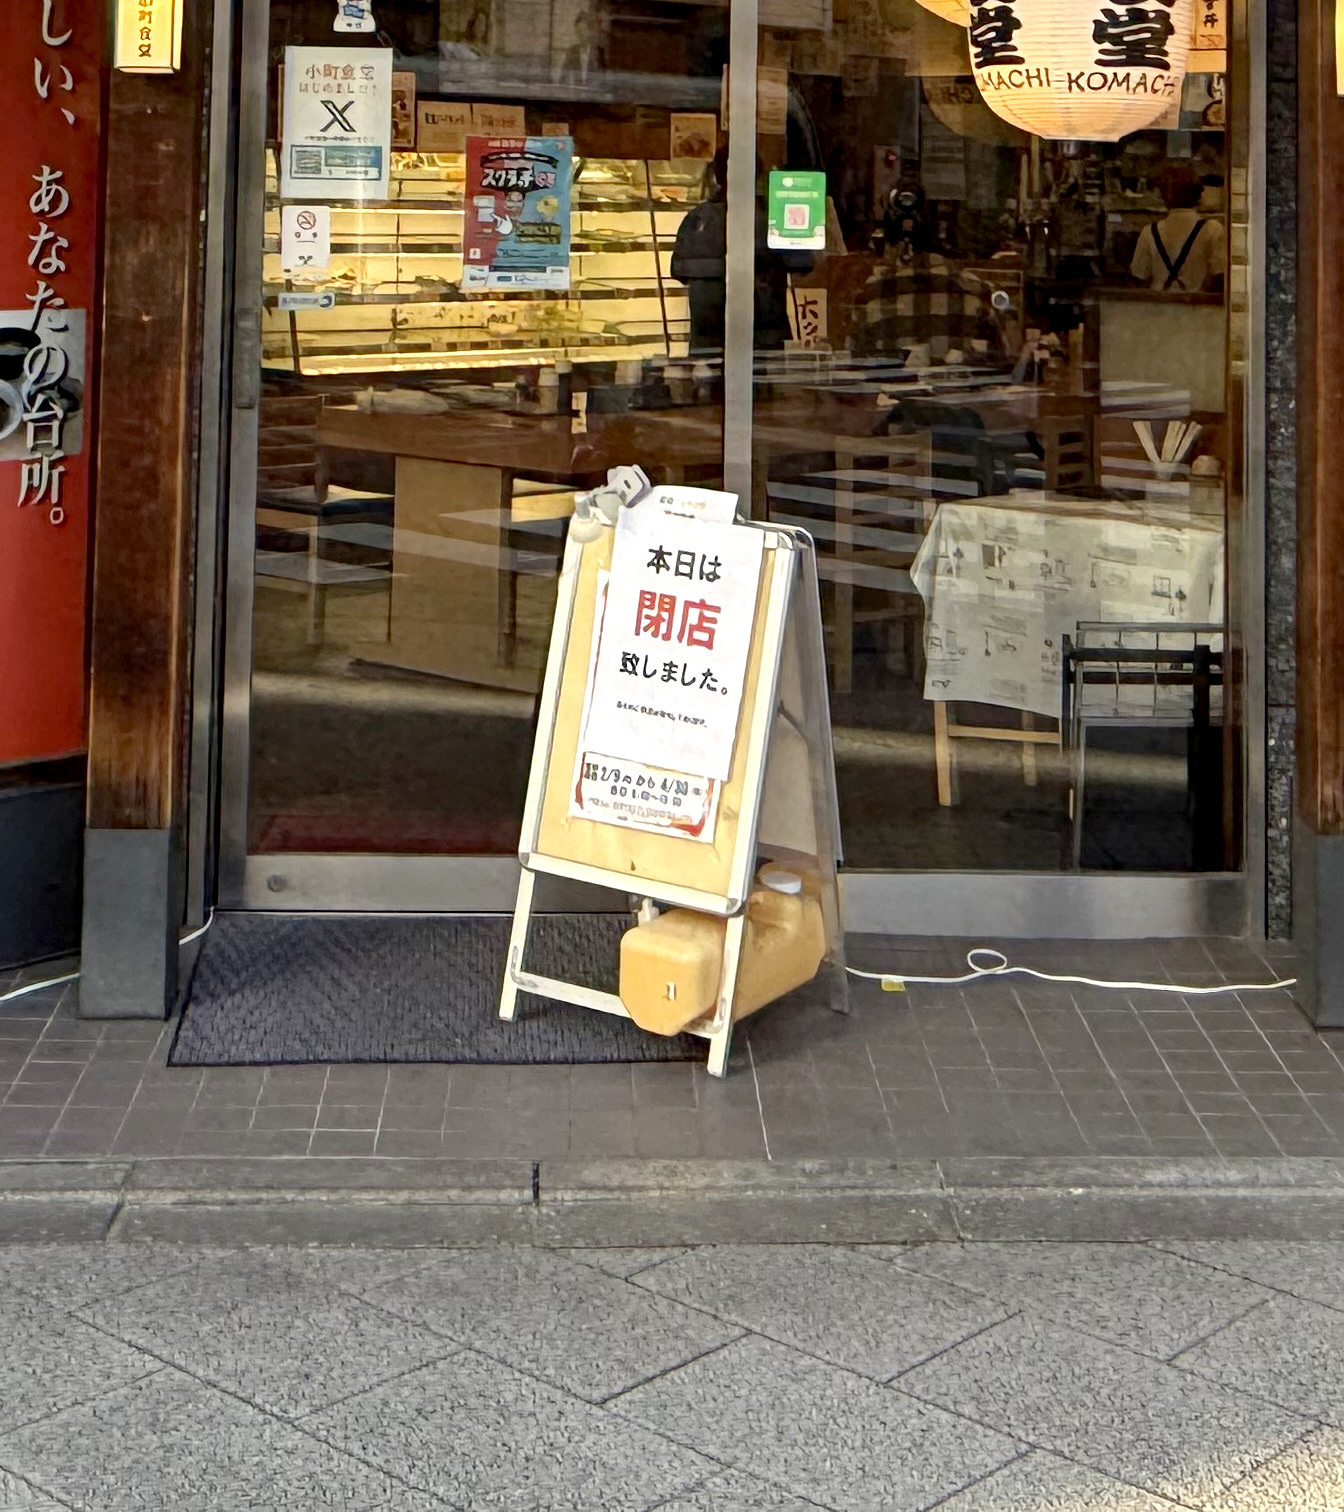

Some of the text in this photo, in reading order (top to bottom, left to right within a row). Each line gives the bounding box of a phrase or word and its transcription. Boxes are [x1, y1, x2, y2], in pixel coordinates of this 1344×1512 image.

[646, 545, 723, 583] 本日は
[634, 589, 722, 651] 閉店
[619, 651, 728, 696] 致しました。
